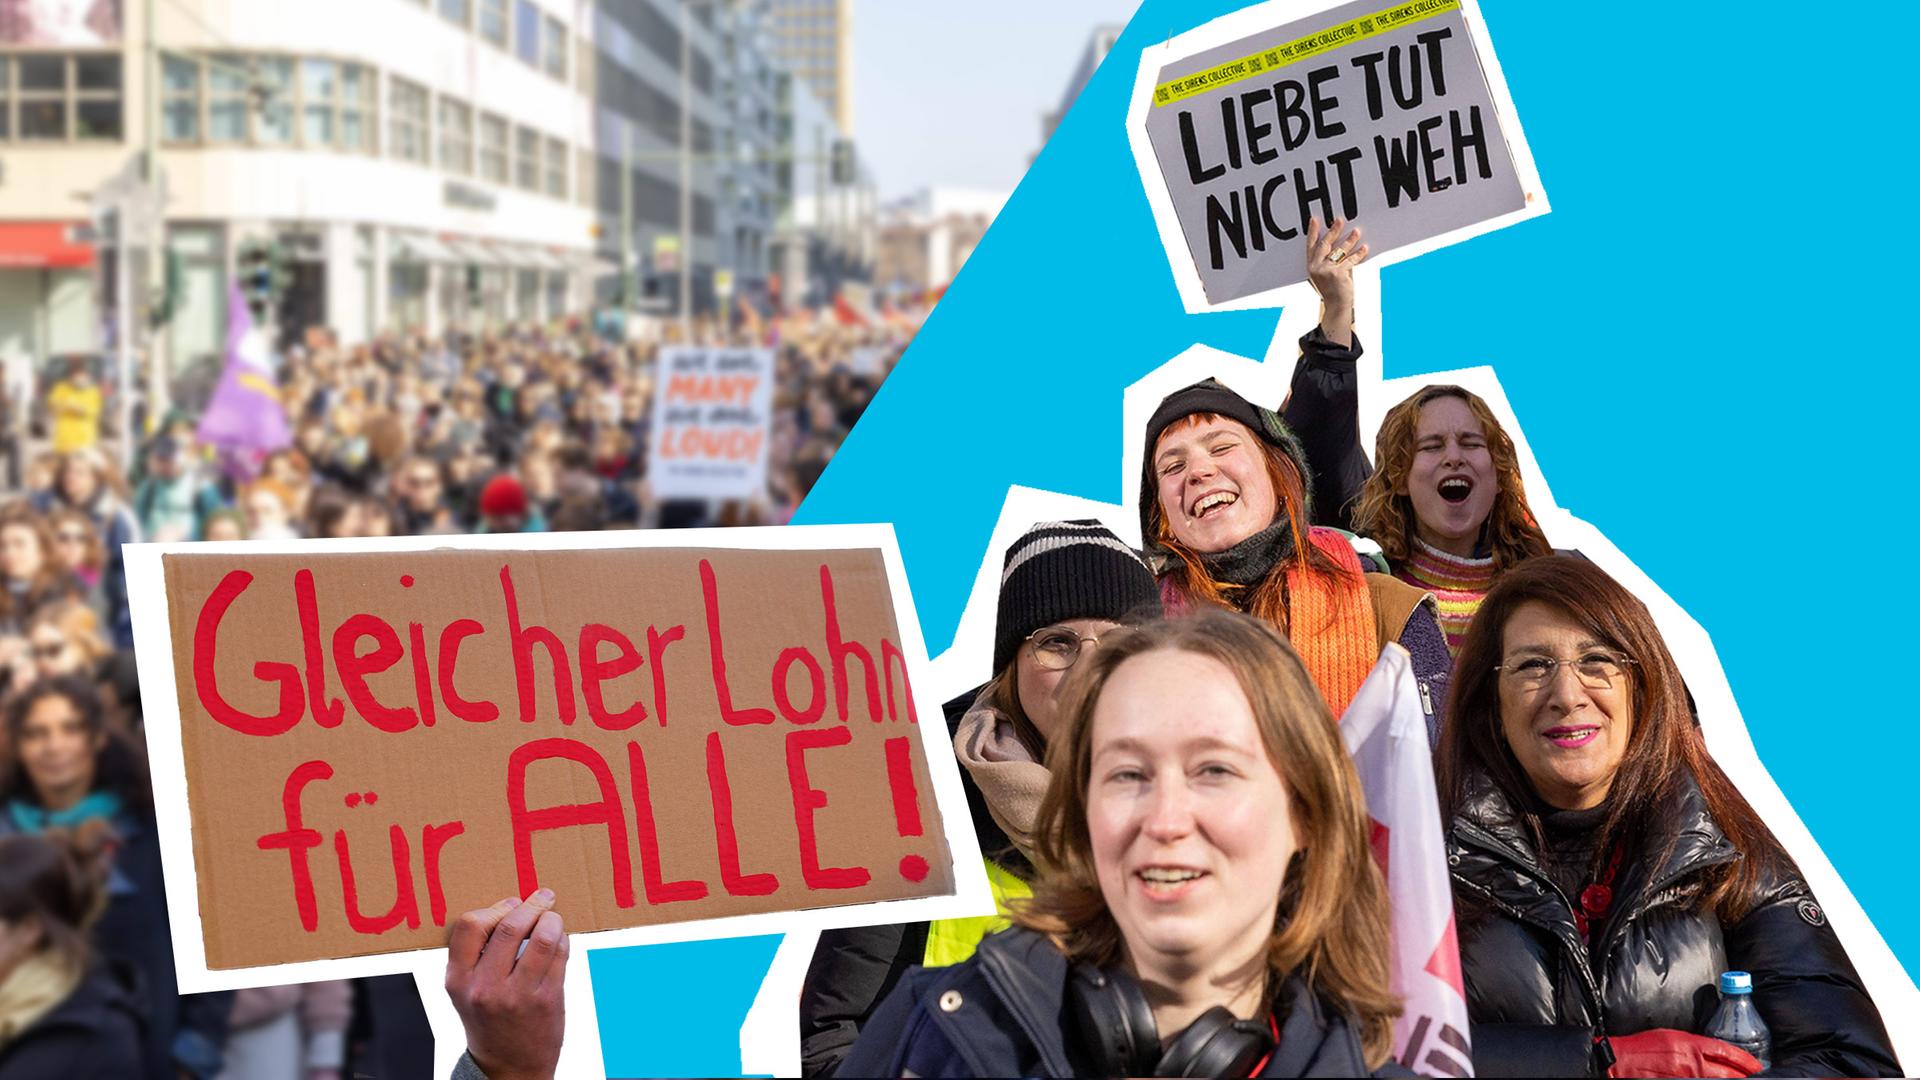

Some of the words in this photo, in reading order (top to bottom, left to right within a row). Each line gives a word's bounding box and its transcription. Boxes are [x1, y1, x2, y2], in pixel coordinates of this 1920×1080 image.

[1280, 46, 1294, 58] THE
[1294, 38, 1318, 54] SIRENS
[1317, 24, 1357, 46] COLLECTIVE
[1375, 14, 1390, 26] THE
[1414, 0, 1455, 14] COLLEC
[1171, 82, 1185, 94] THE
[1184, 75, 1208, 90] SIRENS
[1207, 62, 1246, 83] COLLECTIVE
[1178, 65, 1347, 185] LIEBE
[1350, 26, 1453, 121] TUT
[1206, 146, 1363, 270] NICHT
[1373, 105, 1493, 209] WEH
[665, 373, 761, 408] MANY
[193, 561, 685, 737] Gleicher
[699, 559, 918, 727] Lohn
[256, 759, 465, 935] für
